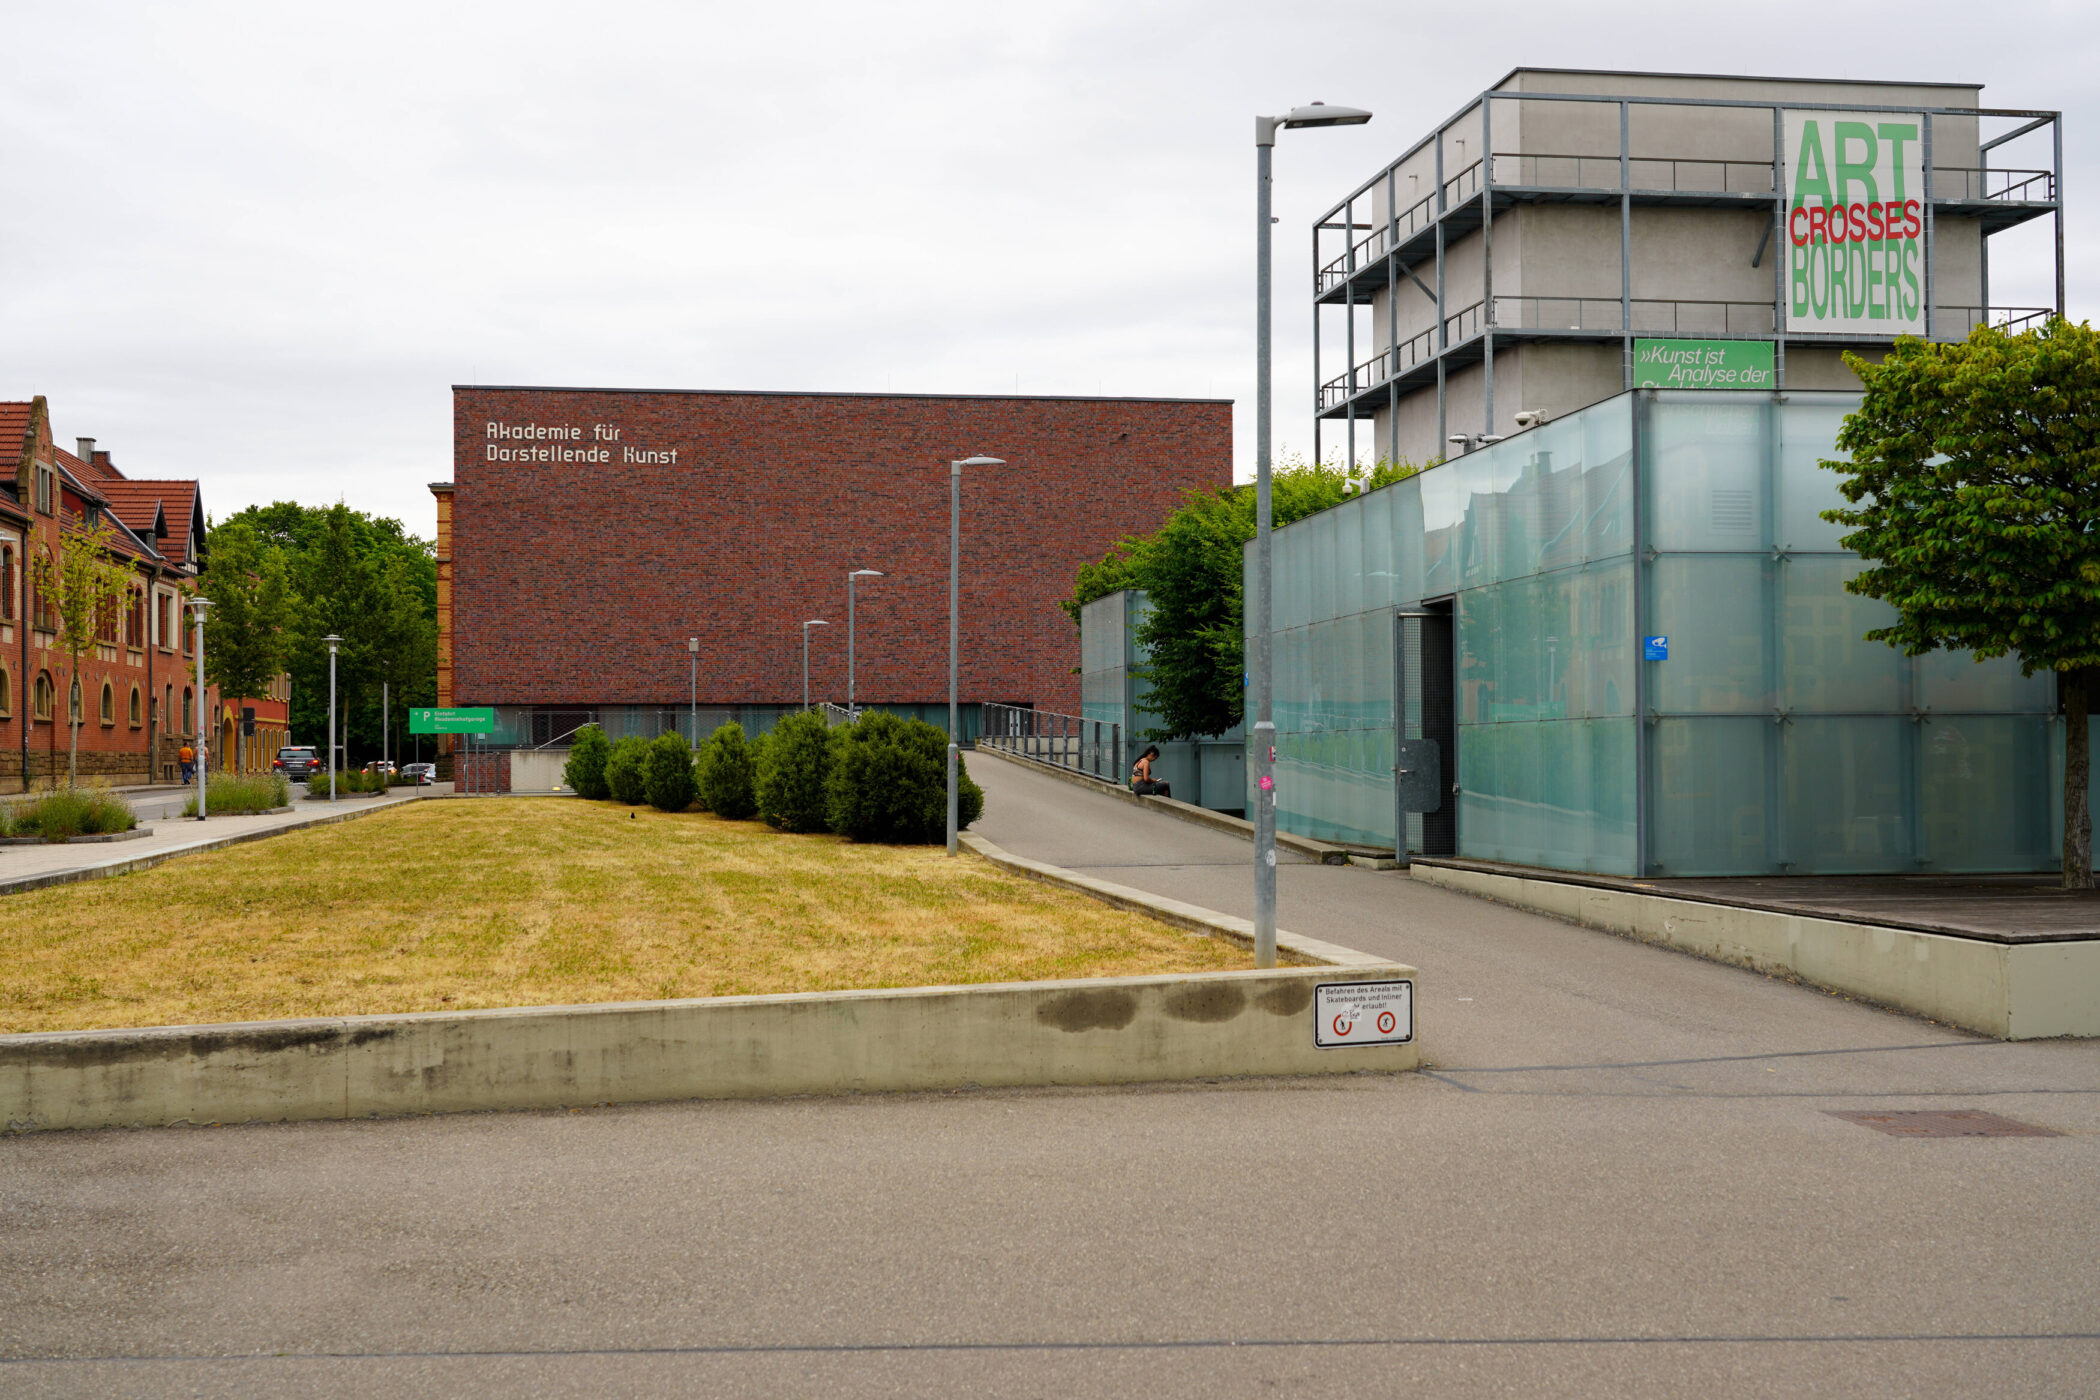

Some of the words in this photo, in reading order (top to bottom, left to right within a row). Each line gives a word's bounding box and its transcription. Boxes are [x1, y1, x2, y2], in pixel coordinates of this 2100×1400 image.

[1791, 120, 1918, 221] ART
[1789, 199, 1921, 247] CROSSES
[1792, 233, 1920, 322] BORDERS
[1704, 347, 1725, 365] ist
[1667, 363, 1737, 386] Analyse
[1740, 365, 1770, 383] der
[486, 421, 582, 440] Akademie
[593, 423, 621, 441] für
[486, 444, 610, 463] Darstellende
[623, 446, 678, 464] Kunst
[423, 711, 431, 721] P
[1325, 987, 1355, 995] Befahren
[1356, 986, 1368, 994] des
[1369, 985, 1391, 993] Areals
[1326, 995, 1367, 1003] Skateboards
